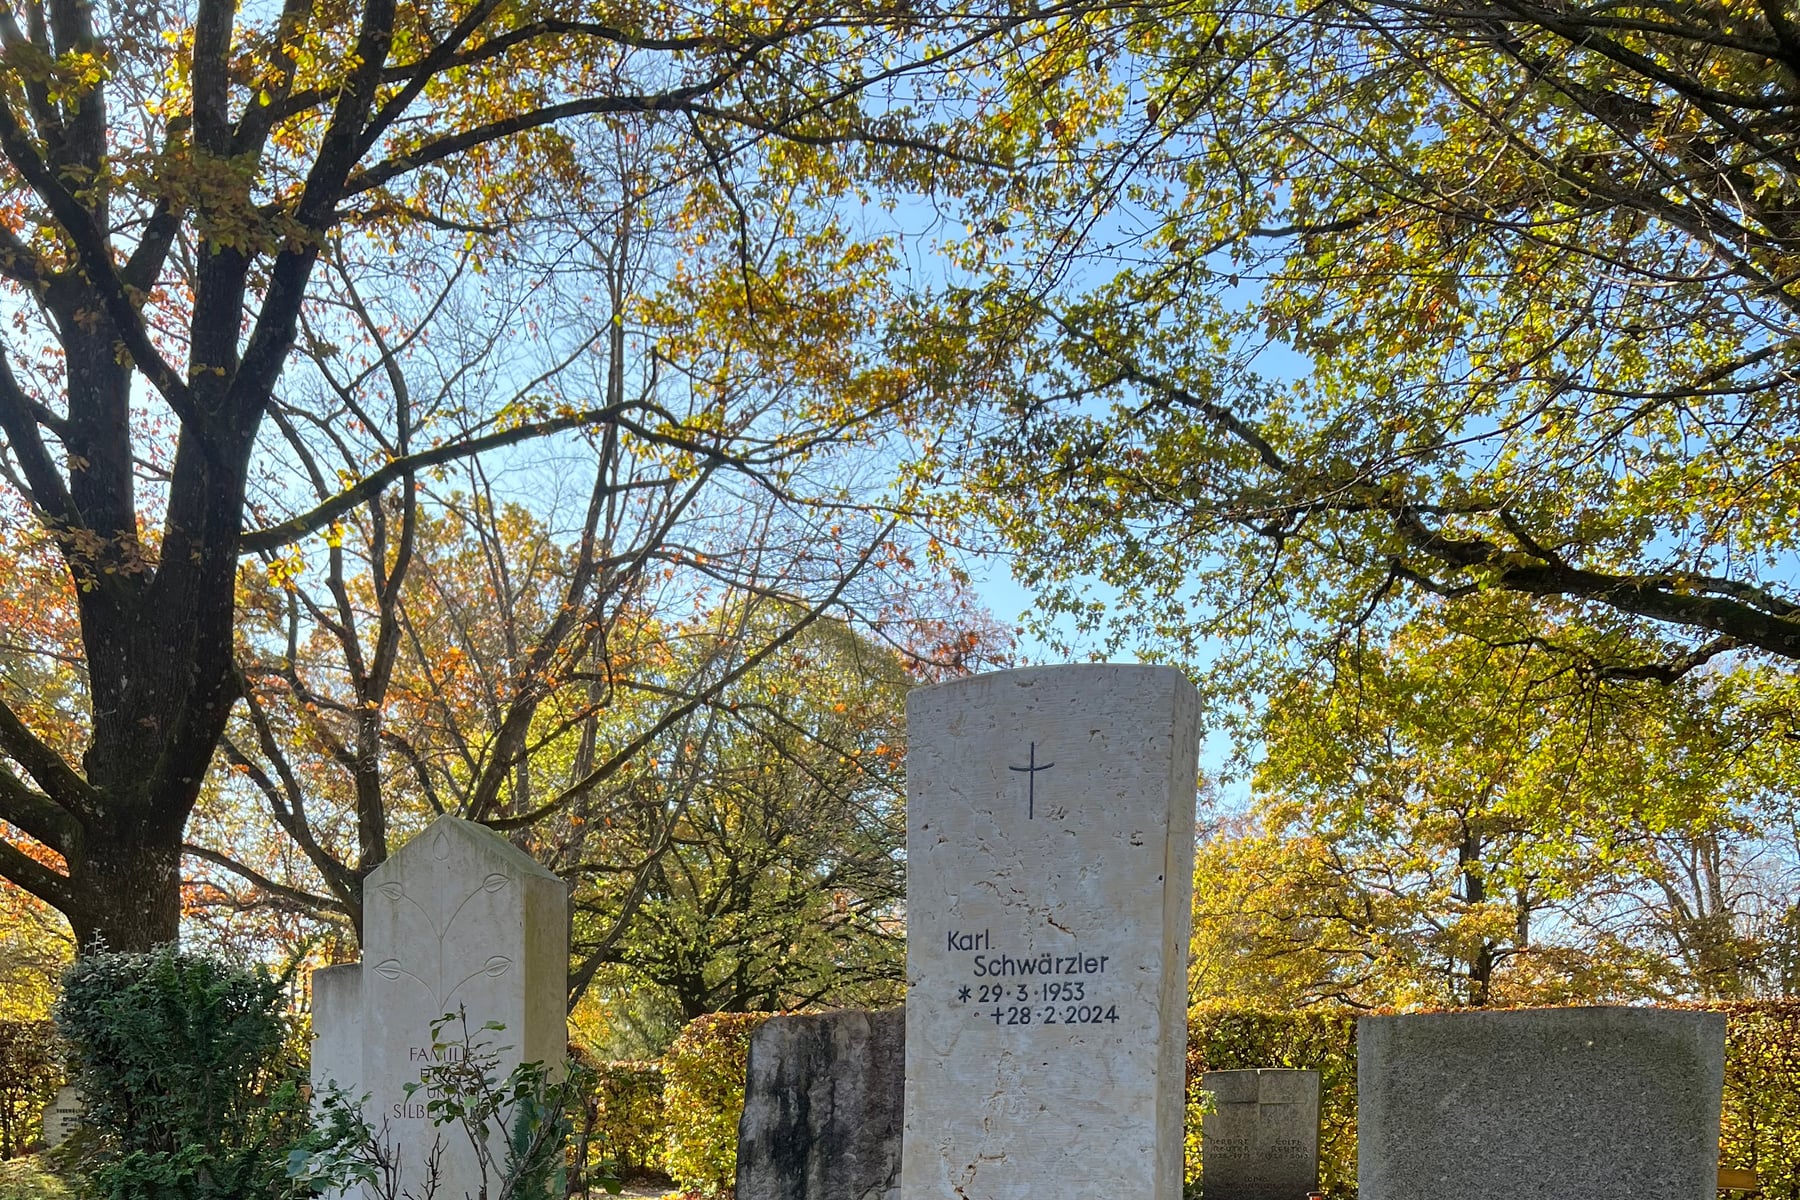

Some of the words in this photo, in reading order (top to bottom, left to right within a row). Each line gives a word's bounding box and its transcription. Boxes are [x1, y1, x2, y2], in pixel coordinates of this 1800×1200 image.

[948, 928, 990, 951] Karl
[973, 952, 1110, 977] Schwärzler
[409, 1047, 476, 1063] FAMILI
